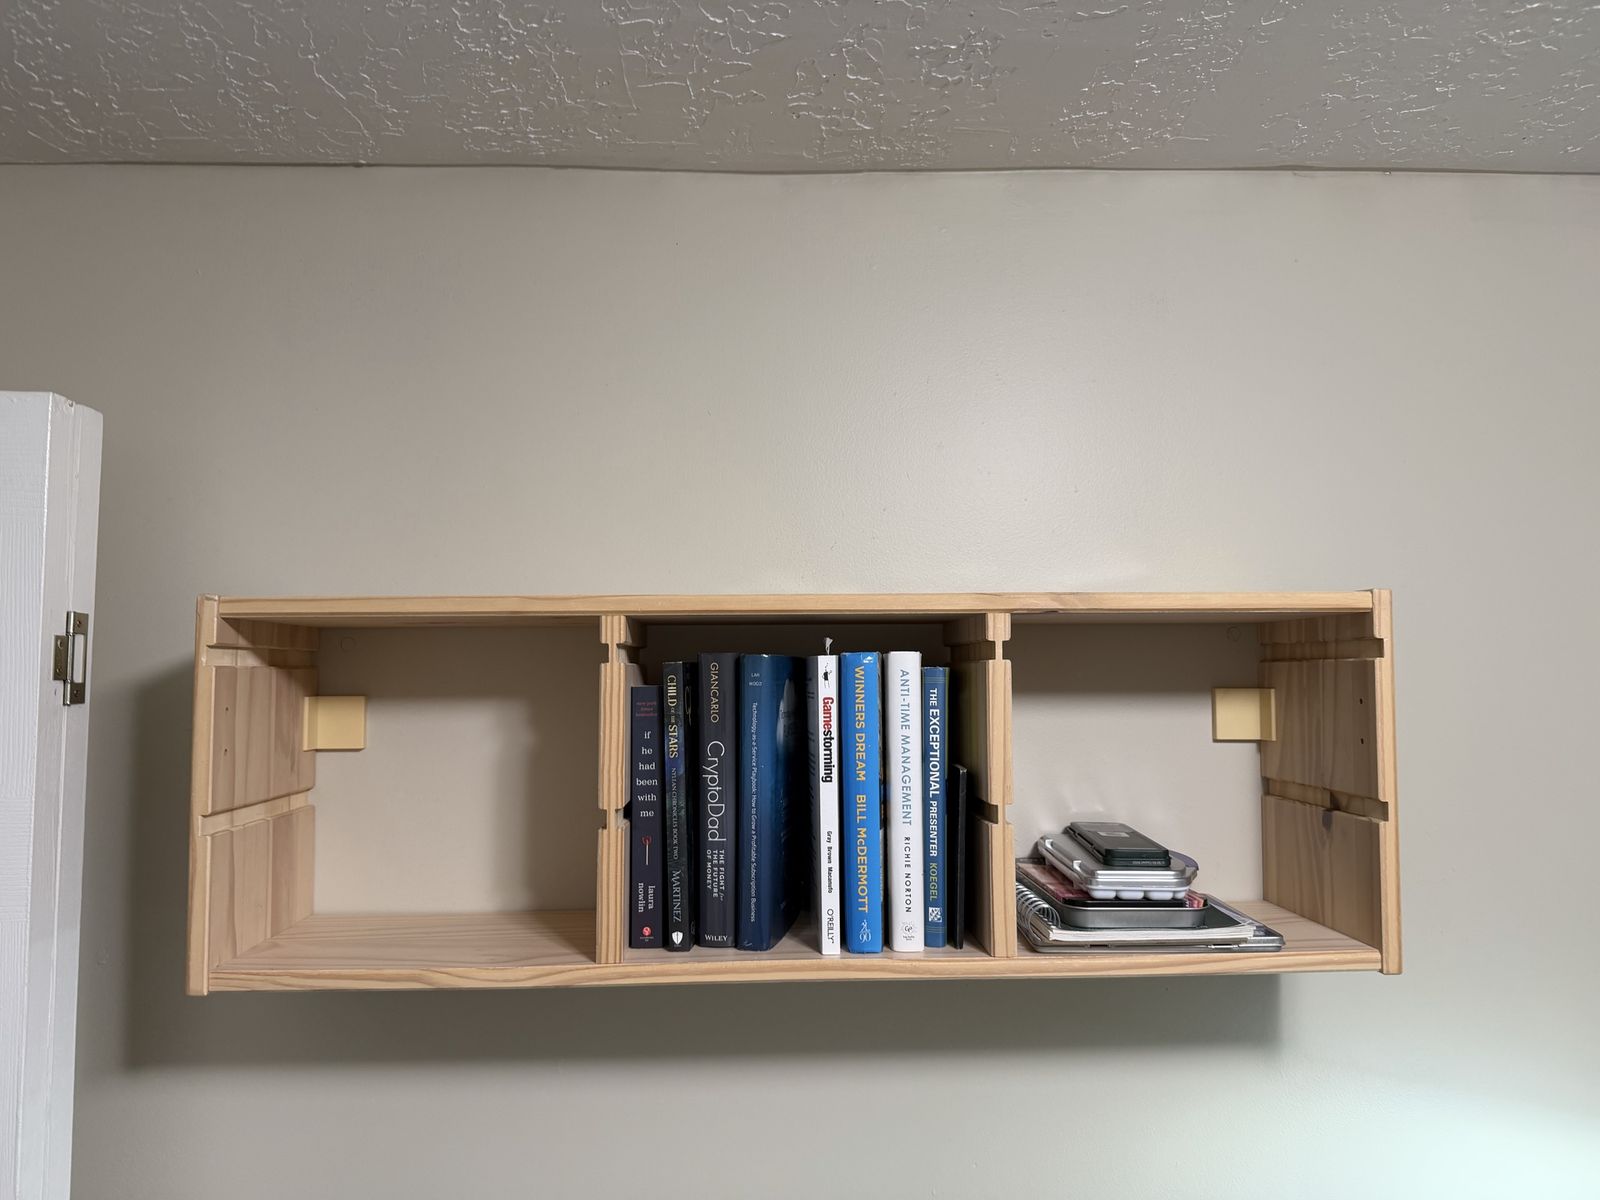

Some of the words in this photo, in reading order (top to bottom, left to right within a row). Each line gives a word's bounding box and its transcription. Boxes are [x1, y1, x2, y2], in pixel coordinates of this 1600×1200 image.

[667, 674, 678, 707] CHILD
[710, 662, 719, 723] GIANCARLO
[854, 665, 865, 729] WINNERS
[900, 669, 910, 730] ANTI-TIME
[930, 688, 938, 706] THE
[642, 746, 652, 754] he
[644, 731, 652, 739] if
[668, 724, 678, 758] STARS
[821, 696, 835, 783] Gamestorming
[855, 732, 866, 781] DREAM
[930, 708, 940, 798] EXCEPTIONAL
[636, 778, 658, 786] been
[638, 762, 656, 770] had
[702, 740, 727, 841] CryptoDad
[900, 734, 912, 825] MANAGEMENT
[856, 794, 867, 824] BILL
[929, 800, 938, 857] PRESENTER
[706, 850, 712, 860] OF
[857, 828, 869, 913] McDERMOTT
[672, 870, 682, 922] MARTINEZ
[930, 862, 938, 901] KOEGEL
